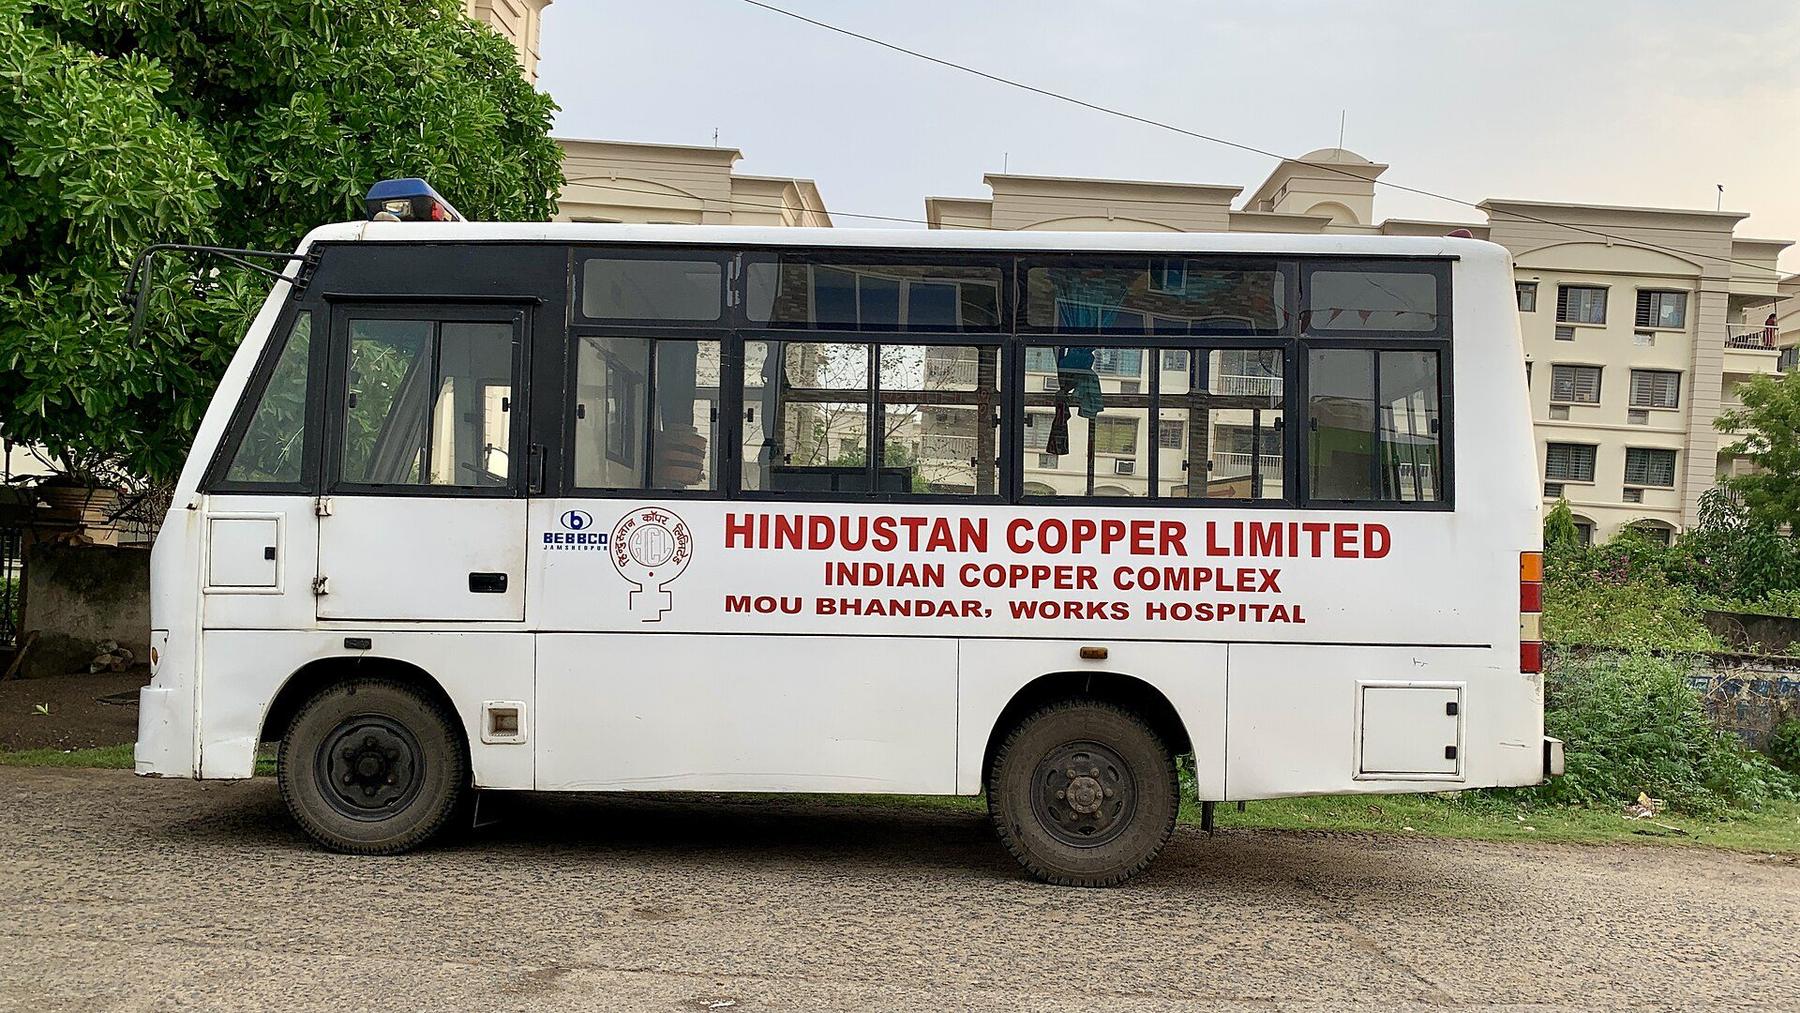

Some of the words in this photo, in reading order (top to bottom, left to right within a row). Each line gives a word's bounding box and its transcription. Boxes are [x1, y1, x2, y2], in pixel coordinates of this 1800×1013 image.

[543, 532, 608, 544] BEBBCO
[641, 510, 669, 525] कॉपर
[672, 523, 689, 565] लिमिटेड
[725, 513, 988, 553] HINDUSTAN
[1006, 518, 1188, 557] COPPER
[1206, 521, 1392, 560] LIMITED
[825, 562, 945, 588] INDIAN
[959, 563, 1098, 590] COPPER
[1113, 566, 1282, 593] COMPLEX
[725, 595, 802, 615] MOU
[816, 598, 992, 618] BHANDAR,
[1009, 601, 1130, 620] WORKS
[1146, 602, 1306, 624] HOSPITAL
